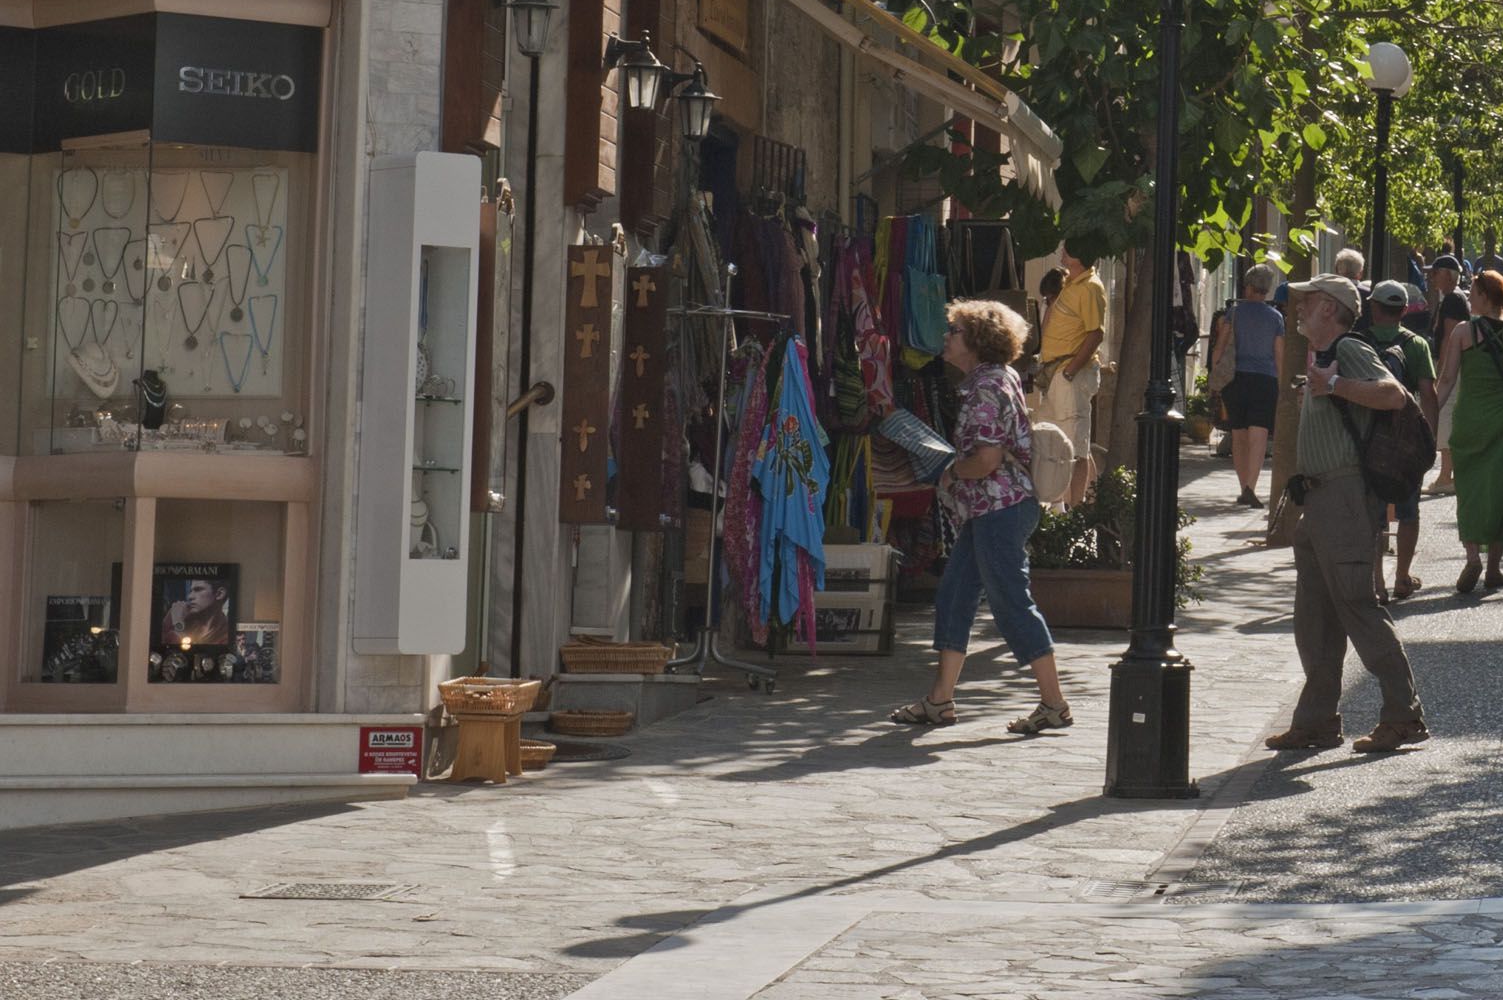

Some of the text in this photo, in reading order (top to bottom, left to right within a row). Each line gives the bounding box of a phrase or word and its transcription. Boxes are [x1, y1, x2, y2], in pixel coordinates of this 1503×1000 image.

[63, 67, 127, 105] GOLD
[178, 66, 297, 102] SEIKO
[372, 734, 412, 742] ARMAOS
